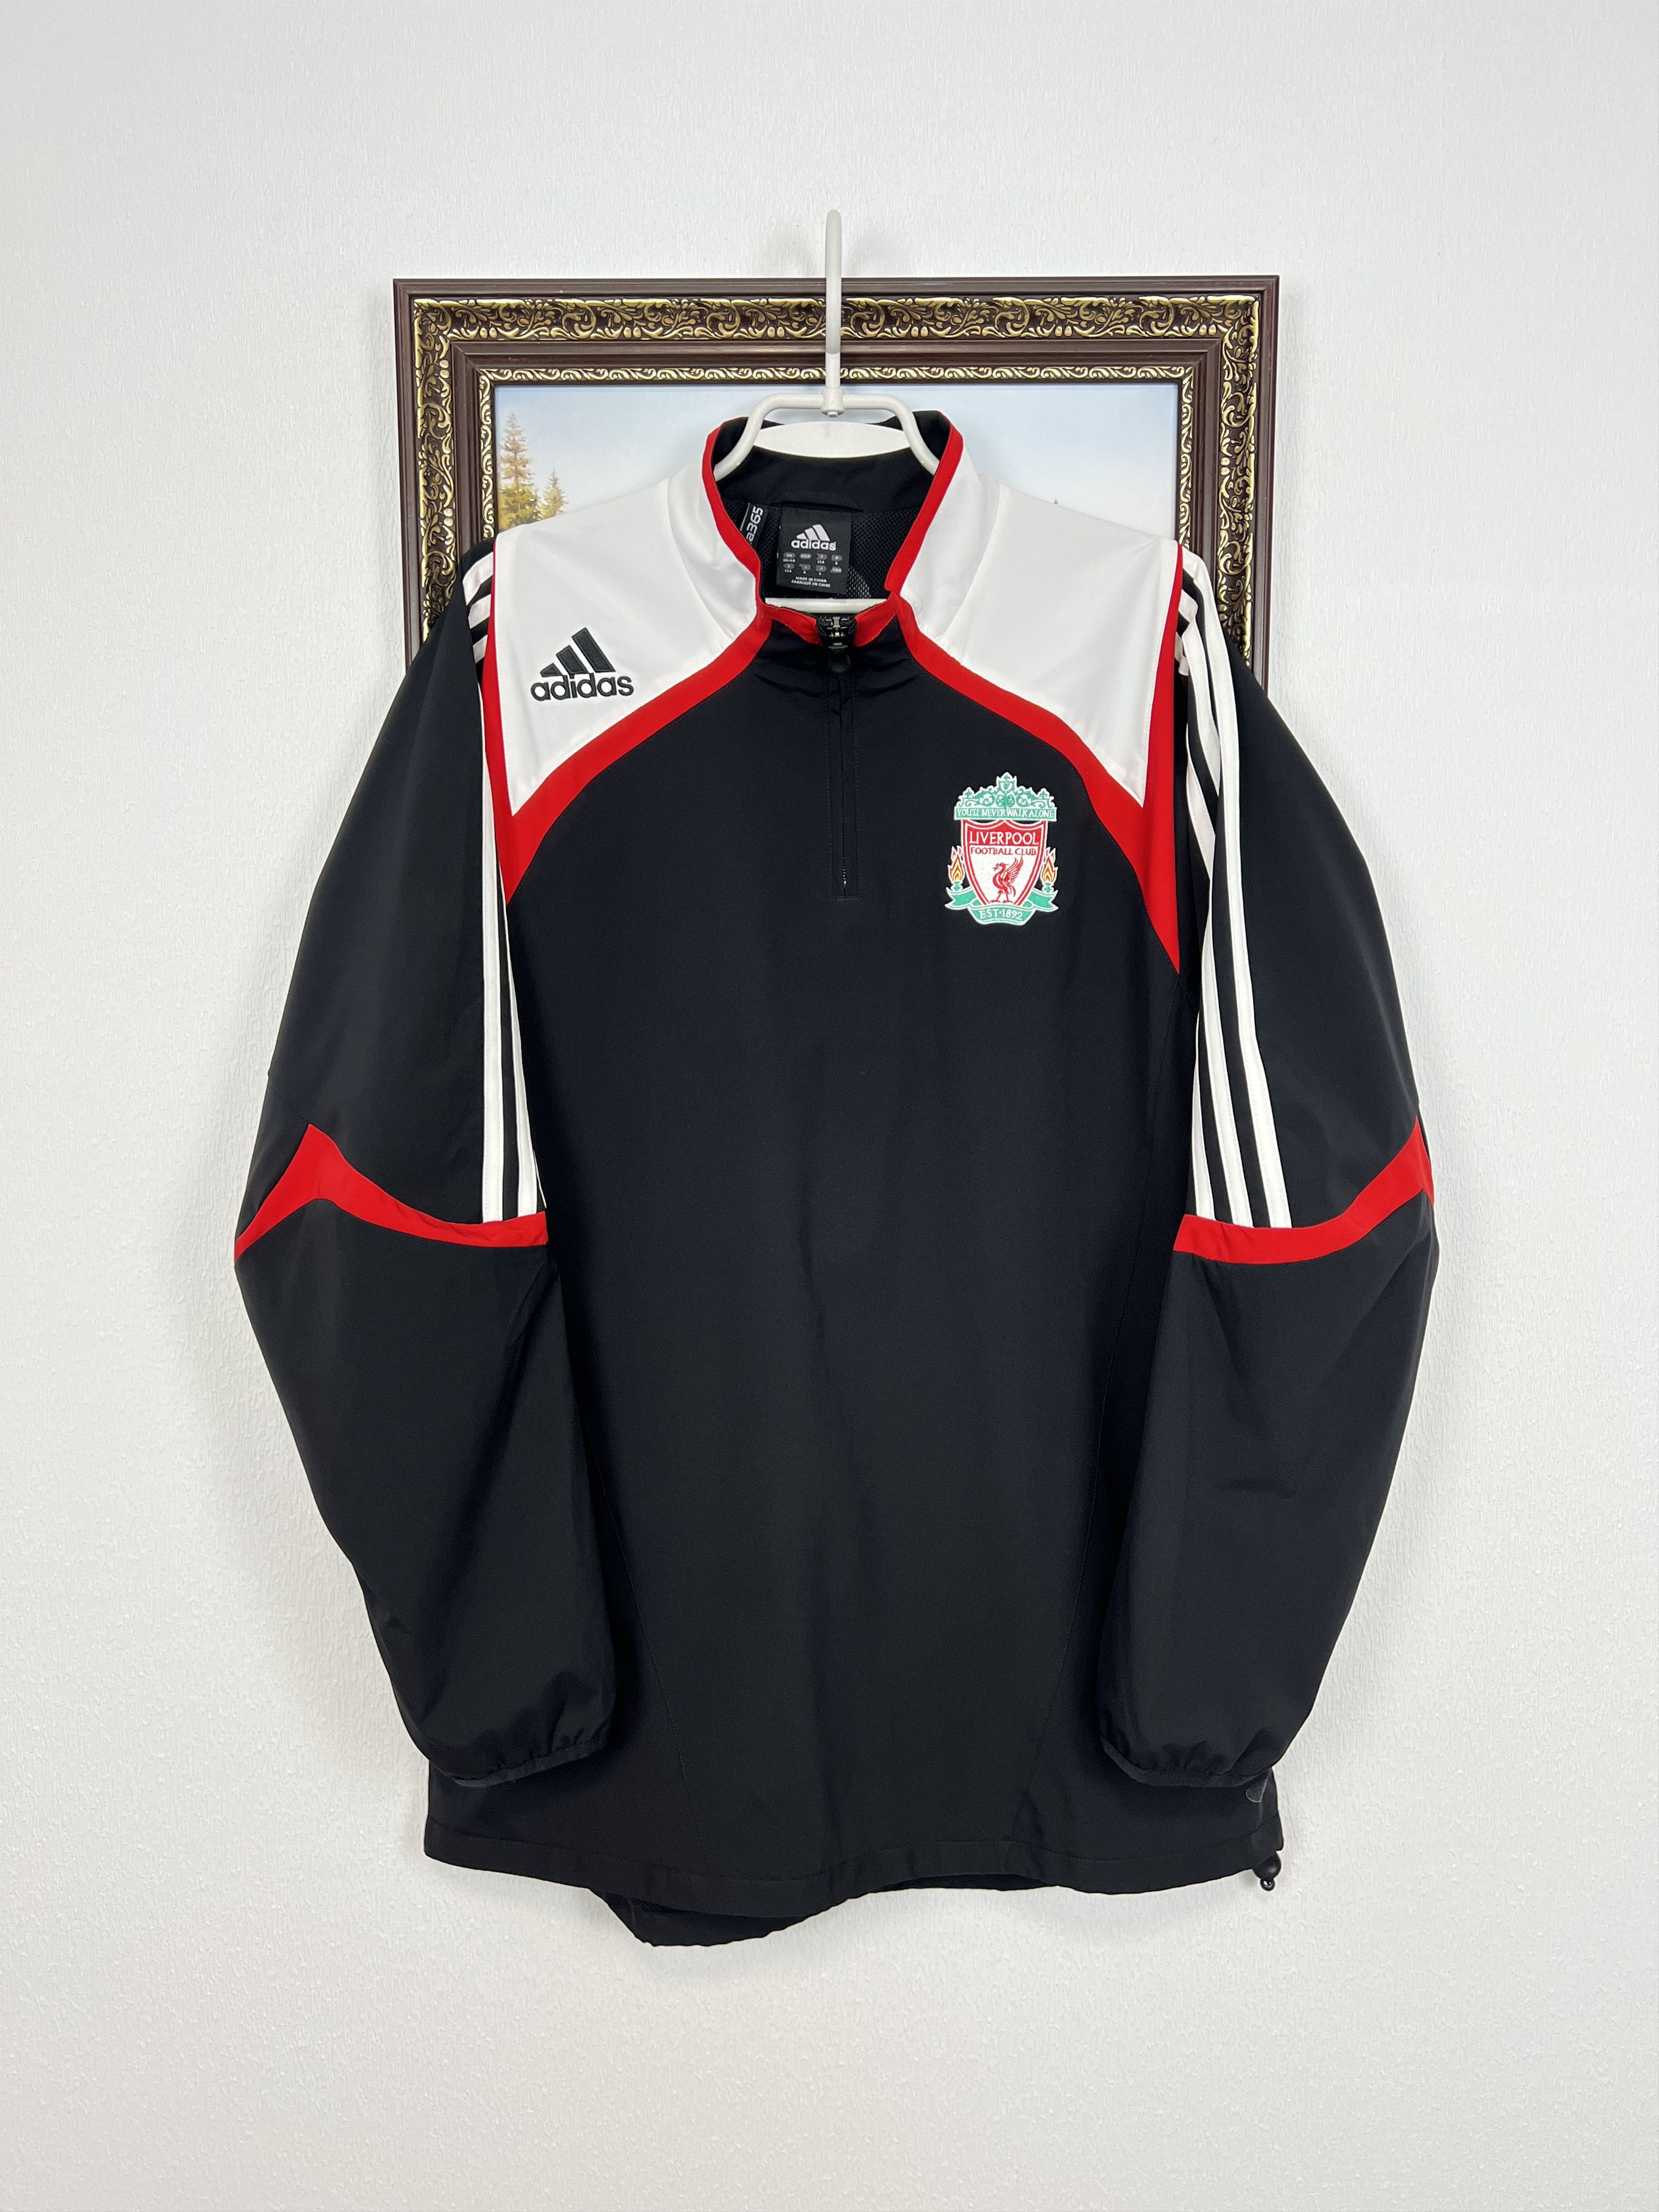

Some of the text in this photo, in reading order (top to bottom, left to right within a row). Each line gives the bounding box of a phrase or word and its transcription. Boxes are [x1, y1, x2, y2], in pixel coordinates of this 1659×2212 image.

[746, 506, 763, 545] a365
[791, 539, 836, 551] adidas
[530, 673, 634, 701] adidas
[981, 808, 1005, 817] NEVER
[1006, 808, 1029, 817] WALK
[1028, 809, 1054, 818] ALONE
[969, 831, 1039, 845] LIVERPOOL
[970, 847, 1037, 856] FOOTBALL CLUB
